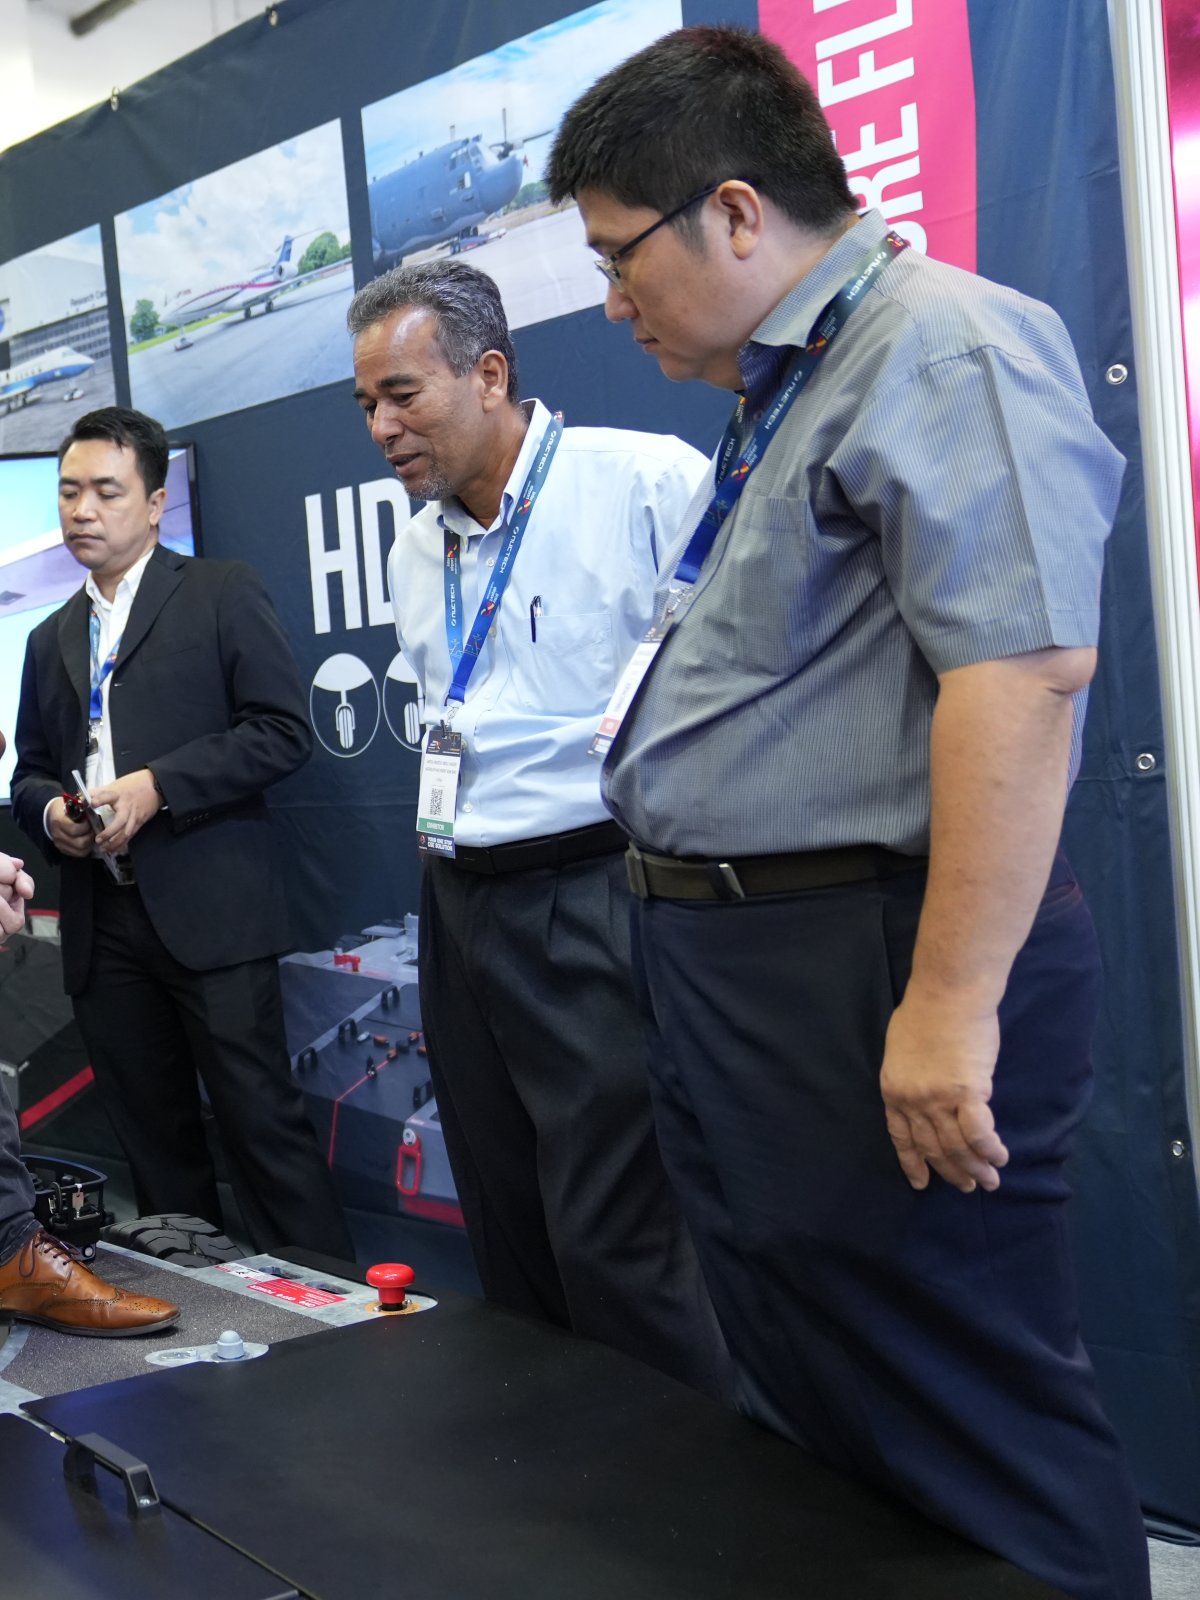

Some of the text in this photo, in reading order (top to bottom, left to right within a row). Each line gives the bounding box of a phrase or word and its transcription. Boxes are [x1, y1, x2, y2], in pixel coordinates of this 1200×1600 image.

[812, 0, 915, 108] FL
[847, 254, 882, 301] NUCTECH
[764, 382, 796, 430] NUCTECH
[536, 438, 555, 474] NUCTECH
[499, 534, 517, 574] NUCTECH
